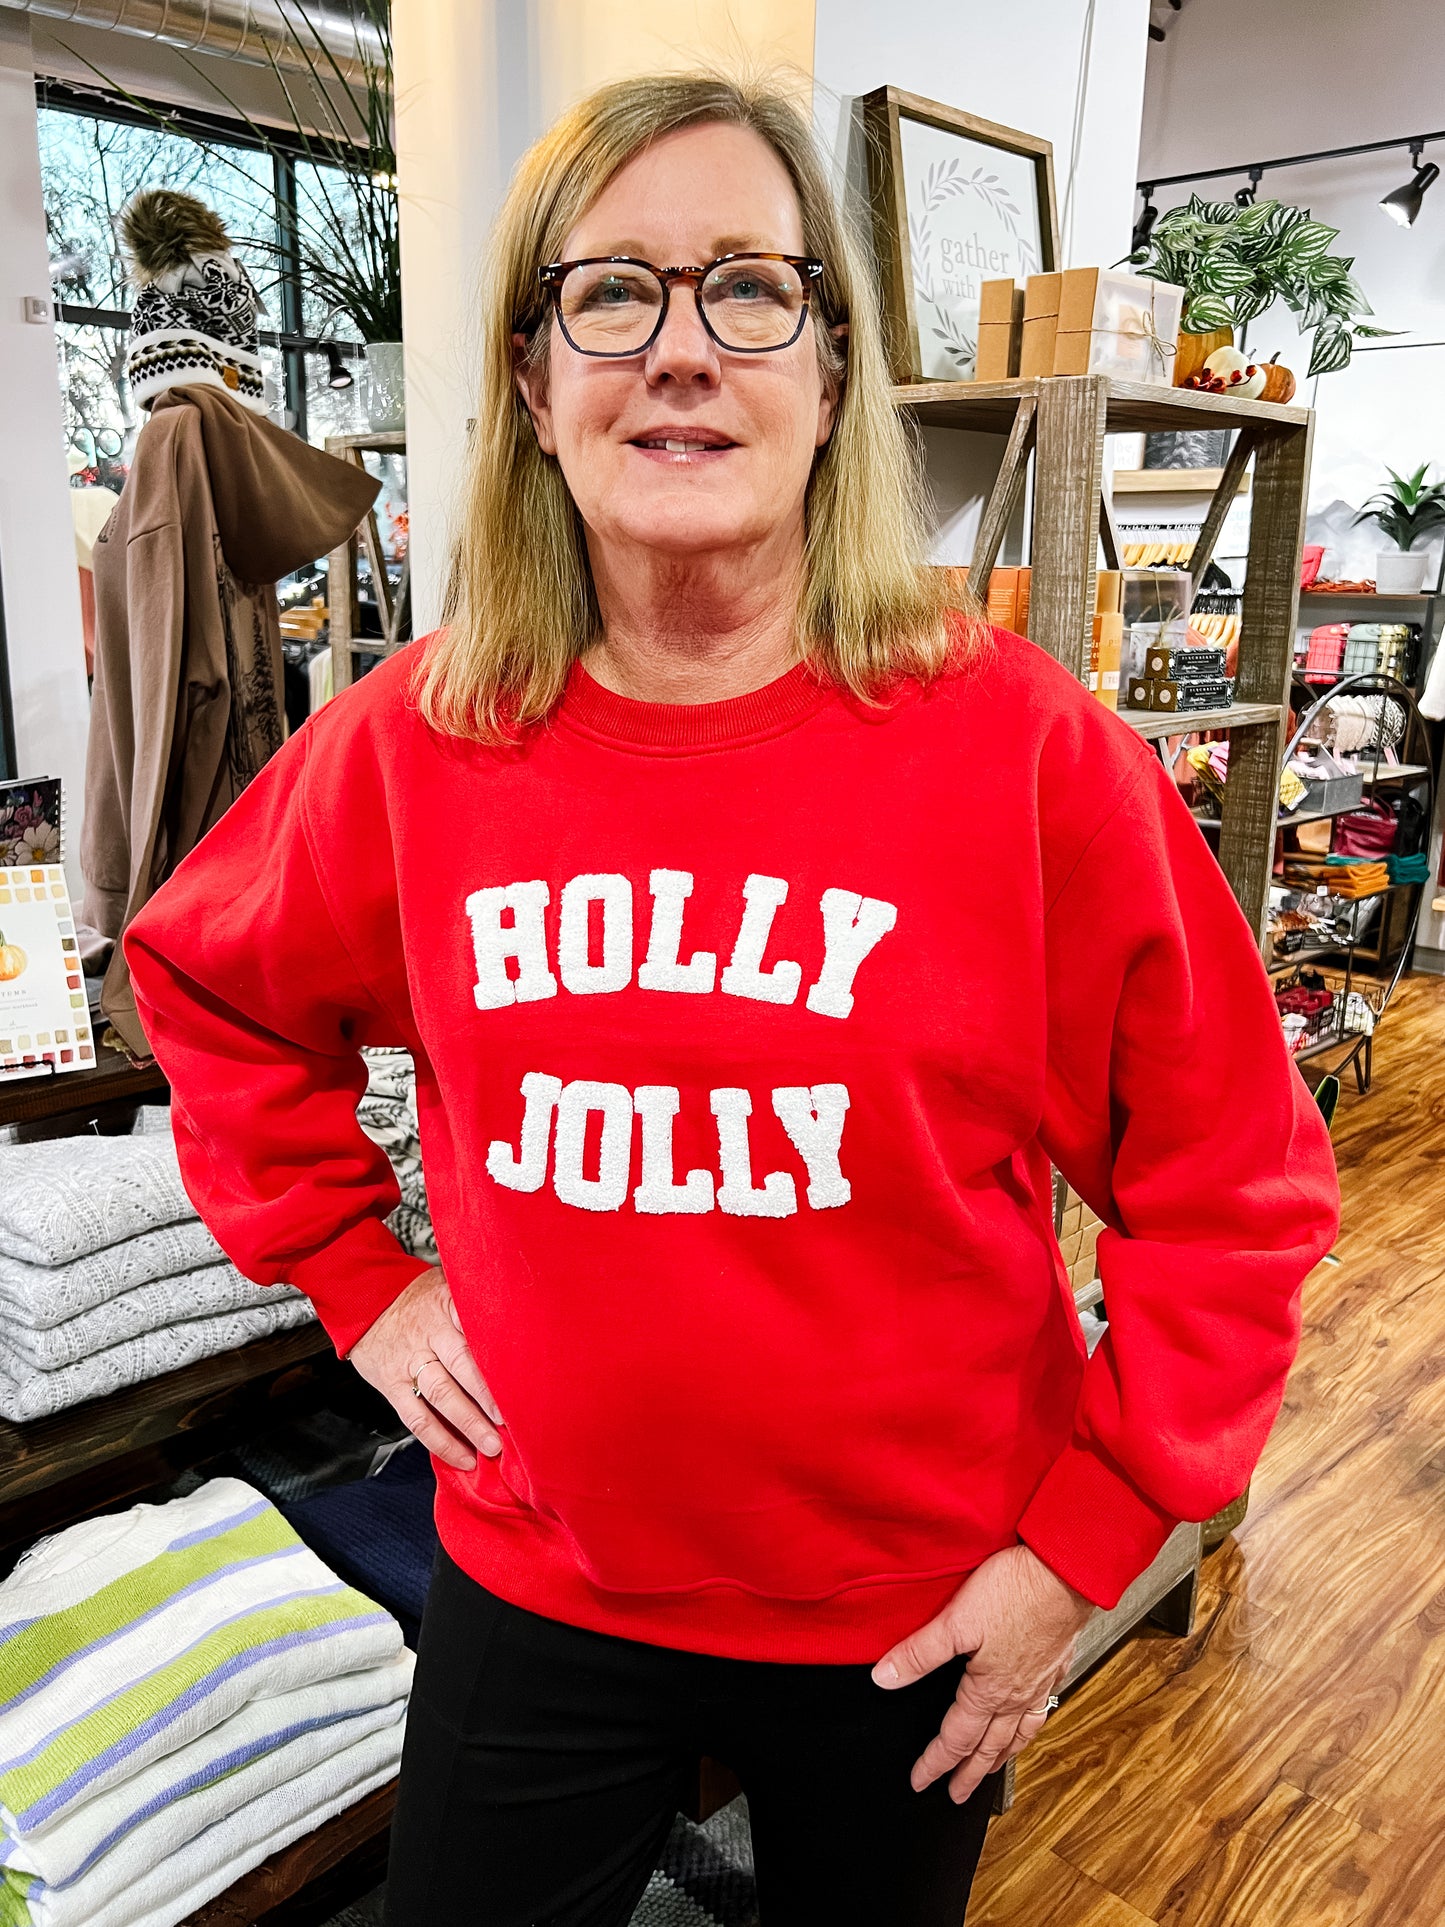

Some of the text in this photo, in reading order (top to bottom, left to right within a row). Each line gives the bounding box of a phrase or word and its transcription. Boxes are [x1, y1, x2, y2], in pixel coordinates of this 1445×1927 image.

[940, 231, 1009, 274] gather
[942, 274, 977, 300] with
[466, 869, 897, 1019] HOLLY
[486, 1072, 851, 1218] JOLLY
